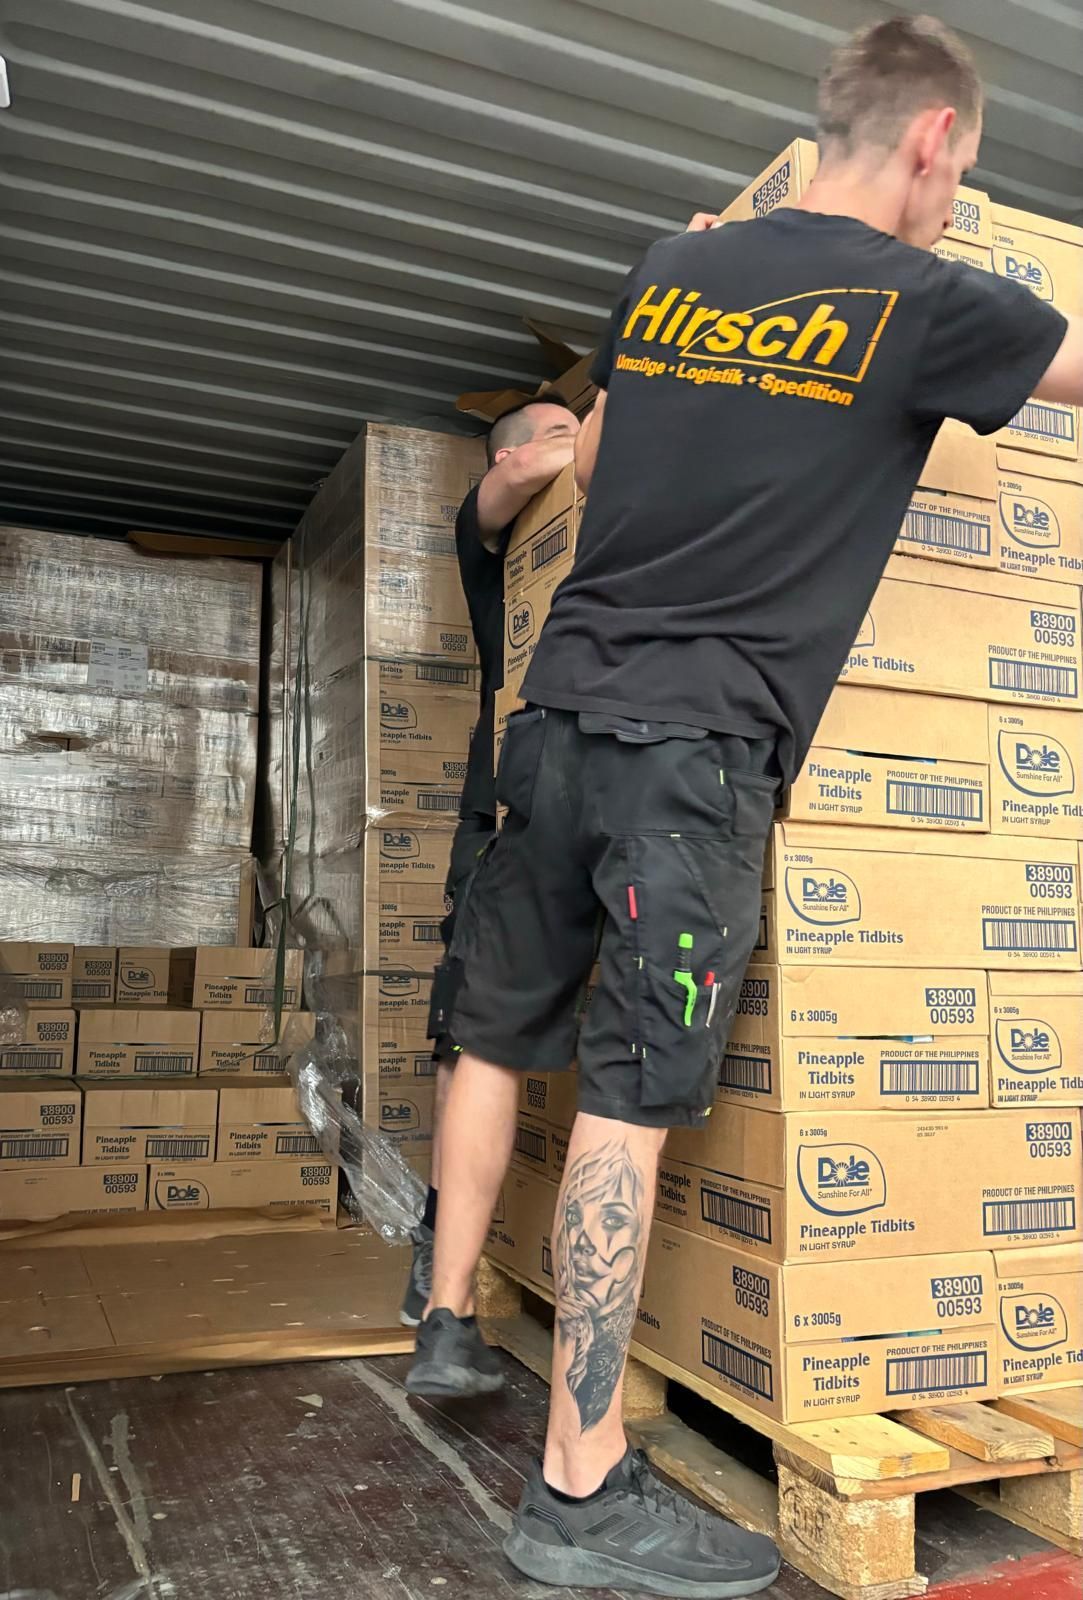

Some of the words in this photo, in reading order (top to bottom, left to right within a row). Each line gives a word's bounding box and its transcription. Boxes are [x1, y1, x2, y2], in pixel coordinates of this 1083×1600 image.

[755, 166, 787, 206] 38900
[953, 201, 977, 218] 900
[954, 217, 978, 234] 593
[1006, 256, 1042, 280] Dole
[622, 285, 849, 365] Hirsch
[616, 354, 665, 375] Umzüge
[676, 363, 744, 385] Logistik
[758, 373, 853, 406] Spedition
[939, 506, 951, 514] THE
[953, 508, 991, 522] PHILIPPINES
[1013, 503, 1049, 526] Dole
[1001, 546, 1055, 566] Pineapple
[513, 609, 529, 632] Dole
[1033, 613, 1072, 631] 38900
[1034, 628, 1075, 647] 00593
[988, 645, 1016, 657] PRODUCT
[1018, 649, 1026, 658] OF
[1027, 650, 1040, 660] THE
[1041, 652, 1077, 665] PHILIPPINES
[872, 656, 915, 673] Tidbits
[381, 703, 408, 717] Dole
[1016, 742, 1060, 770] Dole
[809, 763, 872, 784] Pineapple
[887, 770, 918, 780] PRODUCT
[920, 773, 928, 781] OF
[944, 775, 983, 787] PHILIPPINES
[818, 784, 862, 800] Tidbits
[809, 802, 816, 810] IN
[818, 803, 838, 812] LIGHT
[840, 805, 863, 813] SYRUP
[1003, 800, 1059, 816] Pineapple
[384, 833, 411, 846] Dole
[795, 854, 813, 863] 3005g
[1029, 866, 1070, 881] 38900
[803, 878, 847, 901] Dole
[1030, 883, 1072, 899] 00593
[982, 905, 1012, 914] PRODUCT
[1014, 906, 1022, 914] OF
[1024, 906, 1035, 915] THE
[1037, 907, 1075, 916] PHILIPPINES
[786, 929, 854, 945] Pineapple
[858, 930, 904, 944] Tidbits
[40, 962, 67, 970] 00593
[128, 971, 149, 980] Dole
[204, 984, 238, 992] Pineapple
[928, 990, 973, 1006] 38900
[791, 1010, 796, 1021] 6
[799, 1013, 804, 1021] x
[807, 1011, 838, 1024] 3005g
[931, 1008, 974, 1024] 00593
[39, 1032, 68, 1041] 00593
[1011, 1028, 1049, 1051] Dole
[89, 1051, 127, 1060] Pineapple
[798, 1052, 865, 1067] Pineapple
[95, 1060, 120, 1068] Tidbits
[808, 1072, 854, 1084] Tidbits
[998, 1078, 1056, 1092] Pineapple
[808, 1091, 830, 1099] LIGHT
[42, 1106, 73, 1115] 38900
[382, 1104, 411, 1119] Dole
[42, 1115, 74, 1125] 00593
[230, 1131, 268, 1140] Pineapple
[810, 1129, 827, 1137] 3005g
[1029, 1124, 1069, 1140] 38900
[96, 1136, 136, 1145] Pineapple
[101, 1145, 130, 1153] Tidbits
[1030, 1142, 1071, 1158] 00593
[302, 1168, 330, 1176] 38900
[818, 1155, 870, 1186] Dole
[105, 1175, 136, 1184] 38900
[302, 1177, 330, 1186] 00593
[105, 1184, 136, 1194] 00593
[167, 1186, 200, 1200] Dole
[660, 1185, 686, 1203] Tidbits
[701, 1178, 721, 1190] PRODUCT
[723, 1184, 728, 1192] OF
[730, 1187, 738, 1196] THE
[740, 1189, 771, 1206] PHILIPPINES
[818, 1190, 847, 1199] Sunshine
[983, 1188, 1013, 1197] PRODUCT
[1014, 1187, 1022, 1195] OF
[1024, 1187, 1036, 1195] THE
[1038, 1184, 1074, 1194] PHILIPPINES
[800, 1222, 867, 1239] Pineapple
[871, 1219, 915, 1233] Tidbits
[809, 1242, 830, 1250] LIGHT
[832, 1240, 856, 1249] SYRUP
[735, 1269, 768, 1296] 38900
[934, 1276, 980, 1297] 38900
[736, 1289, 768, 1317] 00593
[937, 1298, 982, 1317] 00593
[794, 1315, 800, 1327] 6
[803, 1316, 808, 1326] x
[811, 1312, 841, 1326] 3005g
[1015, 1303, 1054, 1327] Dole
[702, 1317, 722, 1334] PRODUCT
[724, 1326, 729, 1337] OF
[731, 1330, 740, 1343] THE
[741, 1335, 772, 1359] PHILIPPINES
[886, 1346, 920, 1356] PRODUCT
[921, 1345, 931, 1353] OF
[932, 1344, 946, 1352] THE
[947, 1341, 987, 1351] PHILIPPINES
[802, 1353, 871, 1371] Pineapple
[1003, 1353, 1062, 1372] Pineapple
[813, 1376, 860, 1391] Tidbits
[813, 1398, 835, 1406] LIGHT
[836, 1395, 860, 1404] SYRUP
